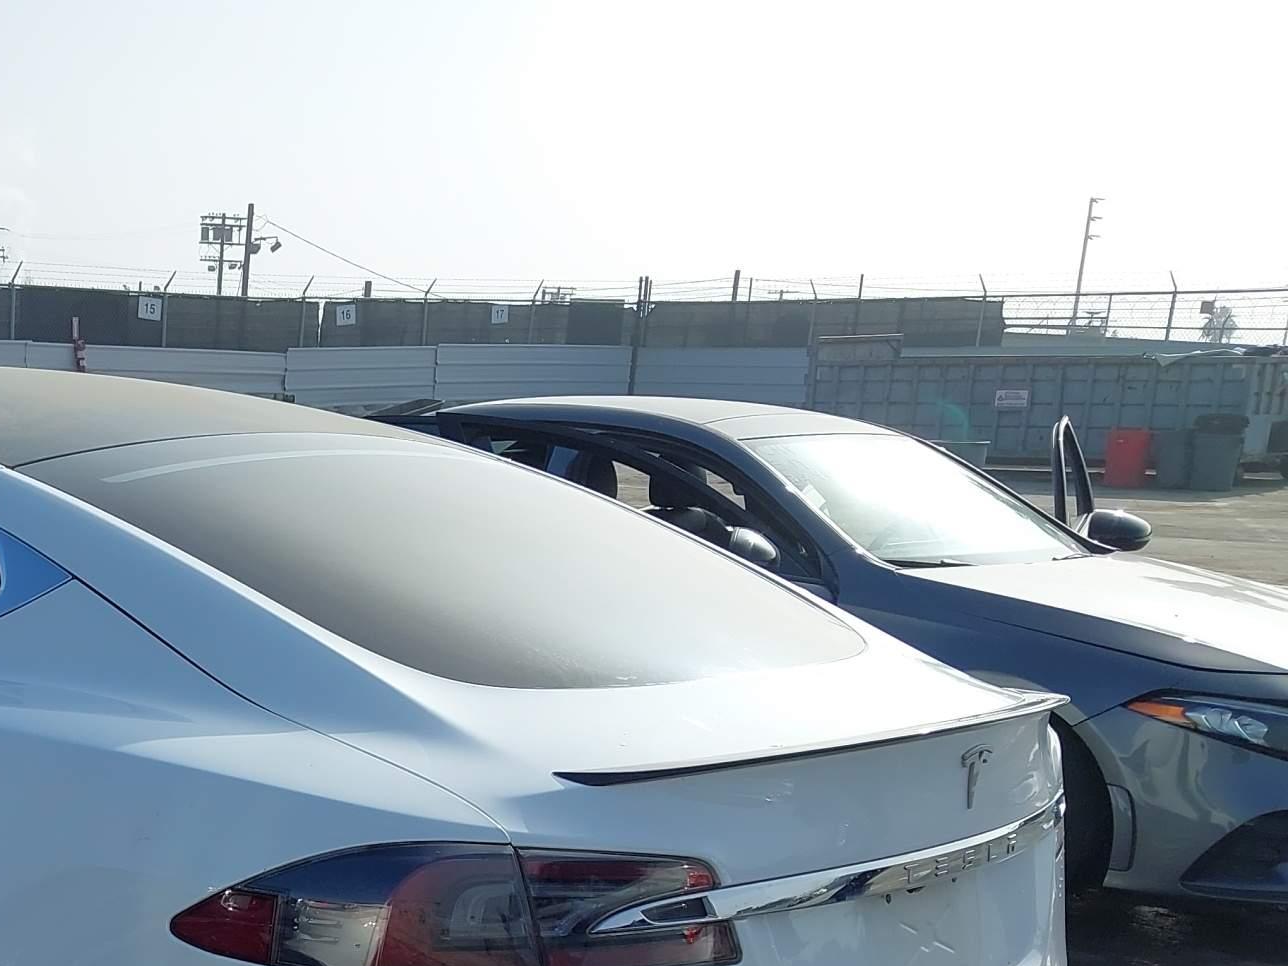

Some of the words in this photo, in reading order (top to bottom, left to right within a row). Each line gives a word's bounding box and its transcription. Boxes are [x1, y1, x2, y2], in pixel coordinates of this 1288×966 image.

[145, 303, 156, 315] 15
[495, 309, 504, 319] 17
[341, 310, 351, 321] 16
[903, 833, 1017, 884] TESLA
